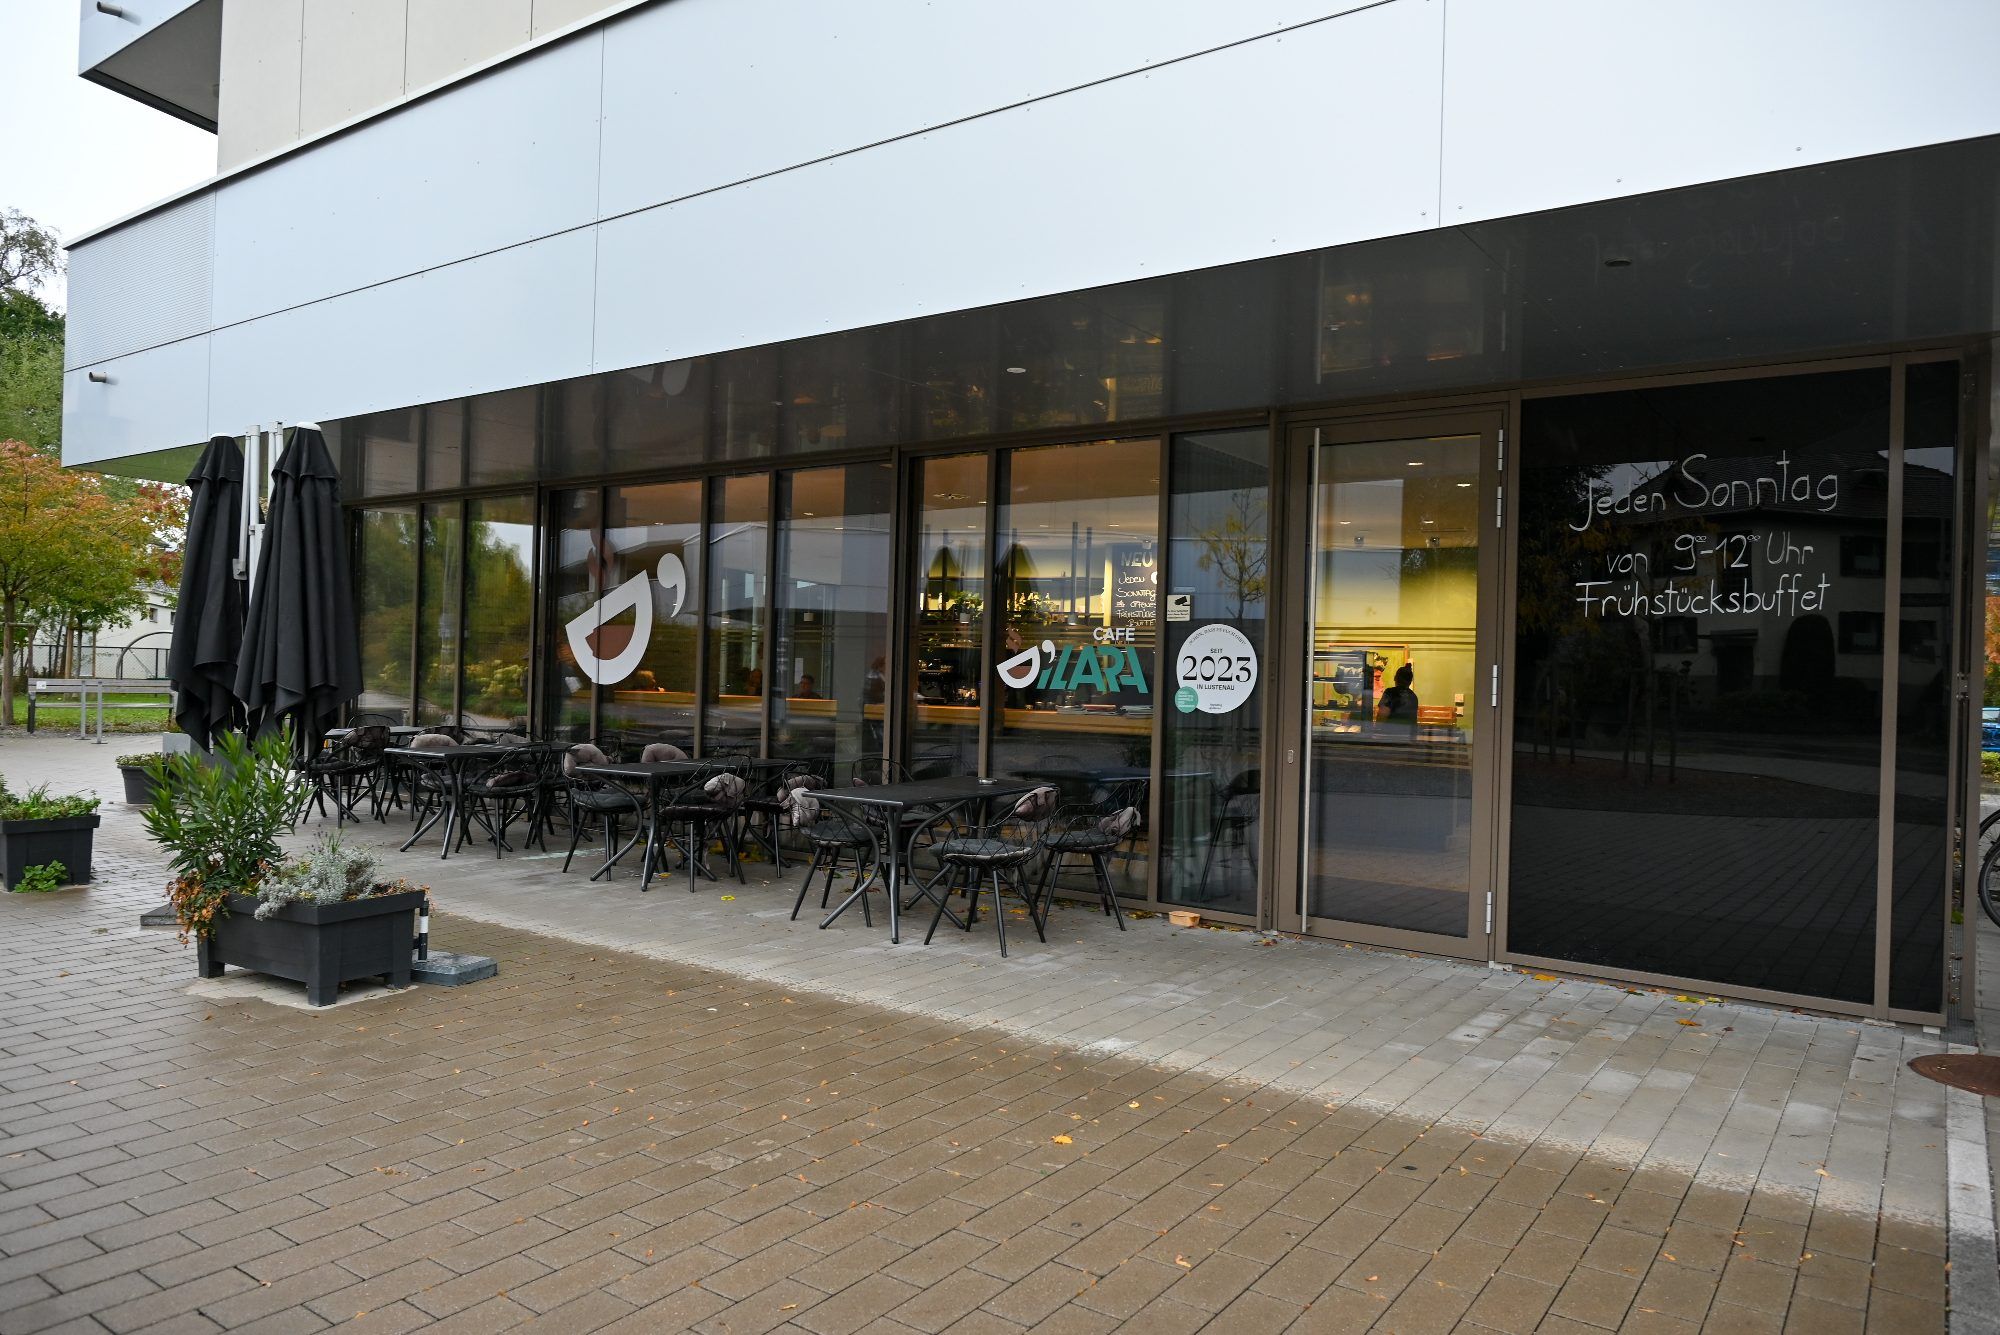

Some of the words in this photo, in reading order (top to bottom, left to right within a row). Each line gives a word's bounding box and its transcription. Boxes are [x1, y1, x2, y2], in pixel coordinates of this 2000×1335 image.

[1673, 450, 1838, 512] Sonntag
[1121, 551, 1154, 568] NEU
[1606, 552, 1648, 574] von
[1766, 531, 1814, 565] Uhr
[1575, 572, 1831, 617] Frühstücksbuffet
[1182, 655, 1252, 683] 2023
